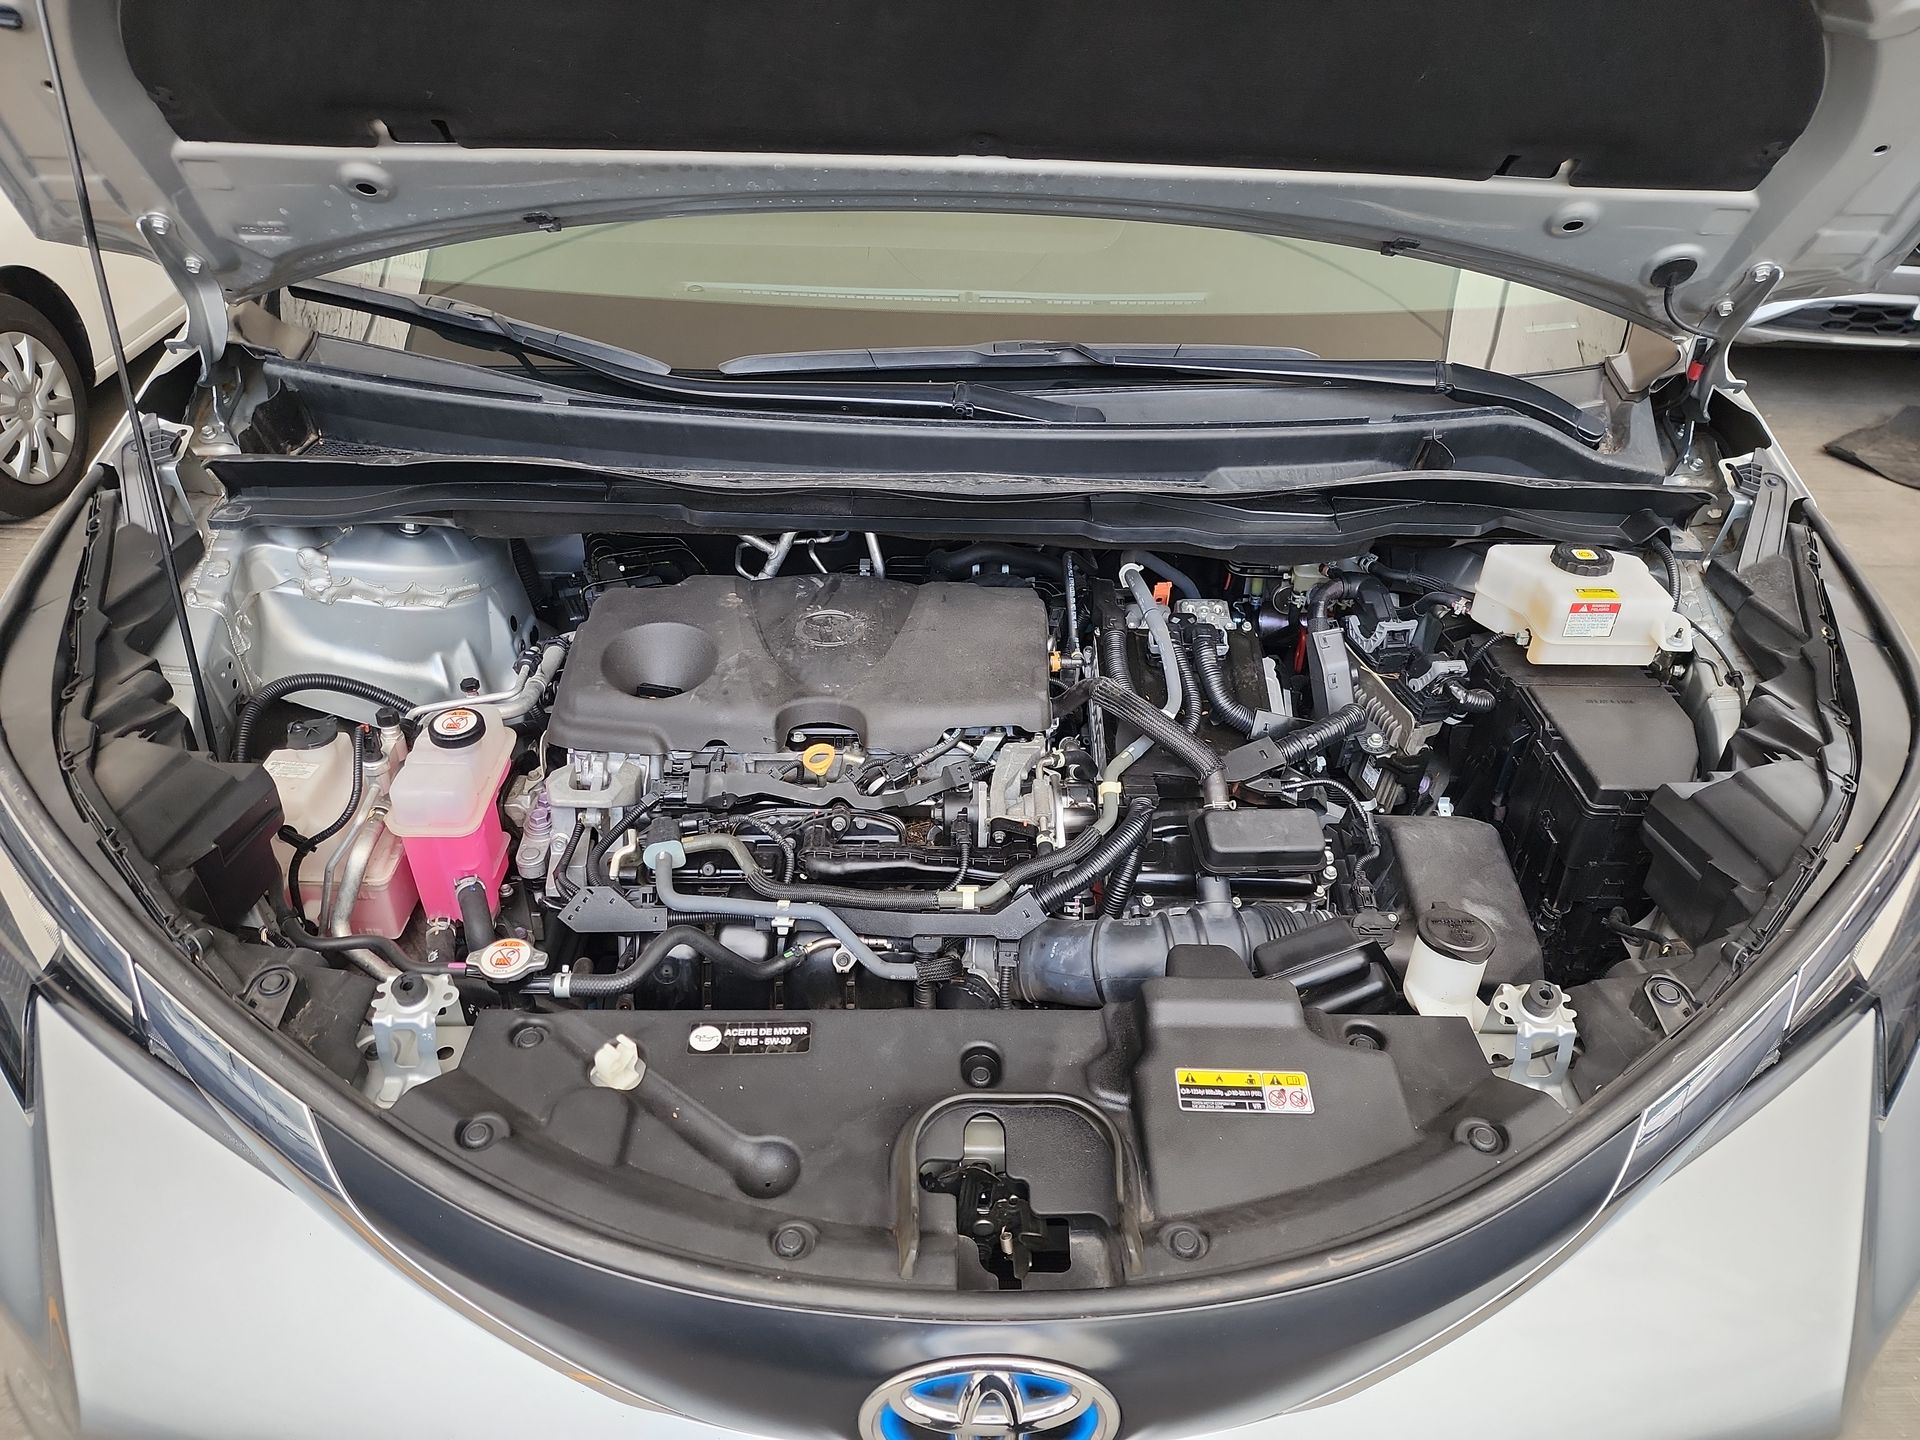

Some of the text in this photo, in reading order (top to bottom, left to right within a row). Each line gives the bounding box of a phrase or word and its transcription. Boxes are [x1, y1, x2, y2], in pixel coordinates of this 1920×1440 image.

[724, 1027, 808, 1037] ACEITE DE MOTOR
[738, 1037, 758, 1046] SAE
[764, 1037, 792, 1046] 5W-30
